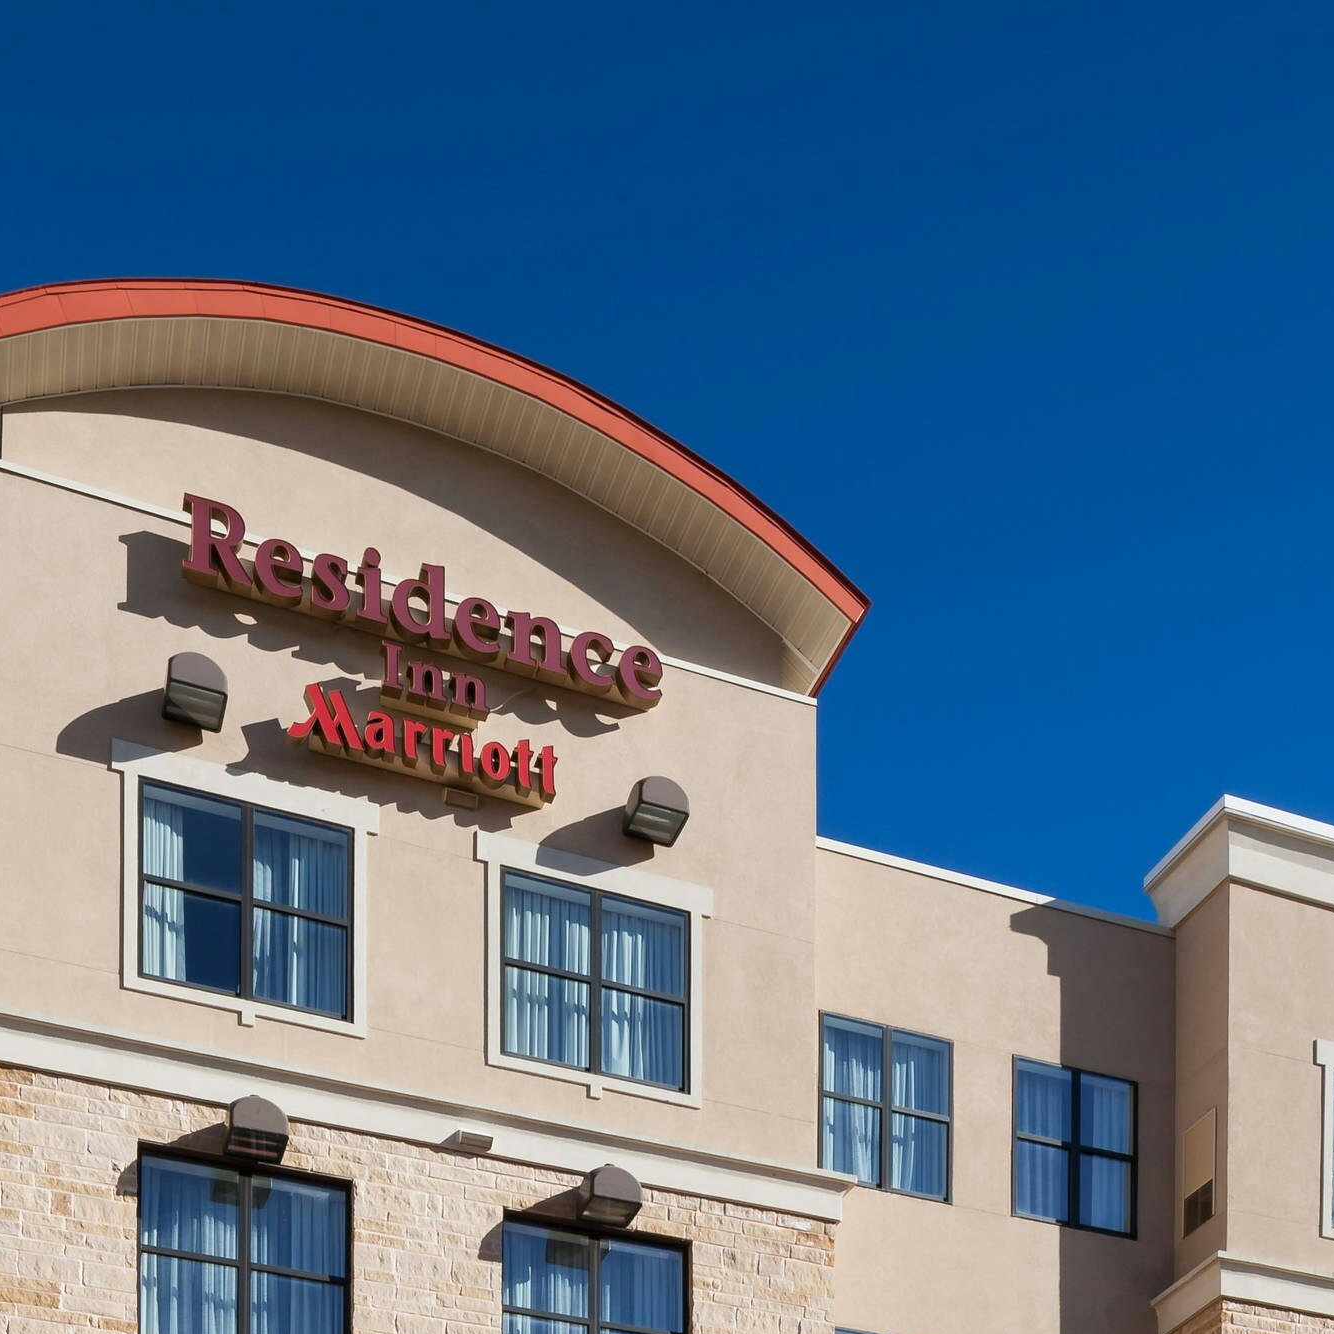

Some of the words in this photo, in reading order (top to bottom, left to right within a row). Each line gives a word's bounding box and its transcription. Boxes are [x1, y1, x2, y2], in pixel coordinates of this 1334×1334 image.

[182, 492, 663, 706] Residence
[382, 638, 490, 715] Inn
[286, 682, 558, 798] Marriott
